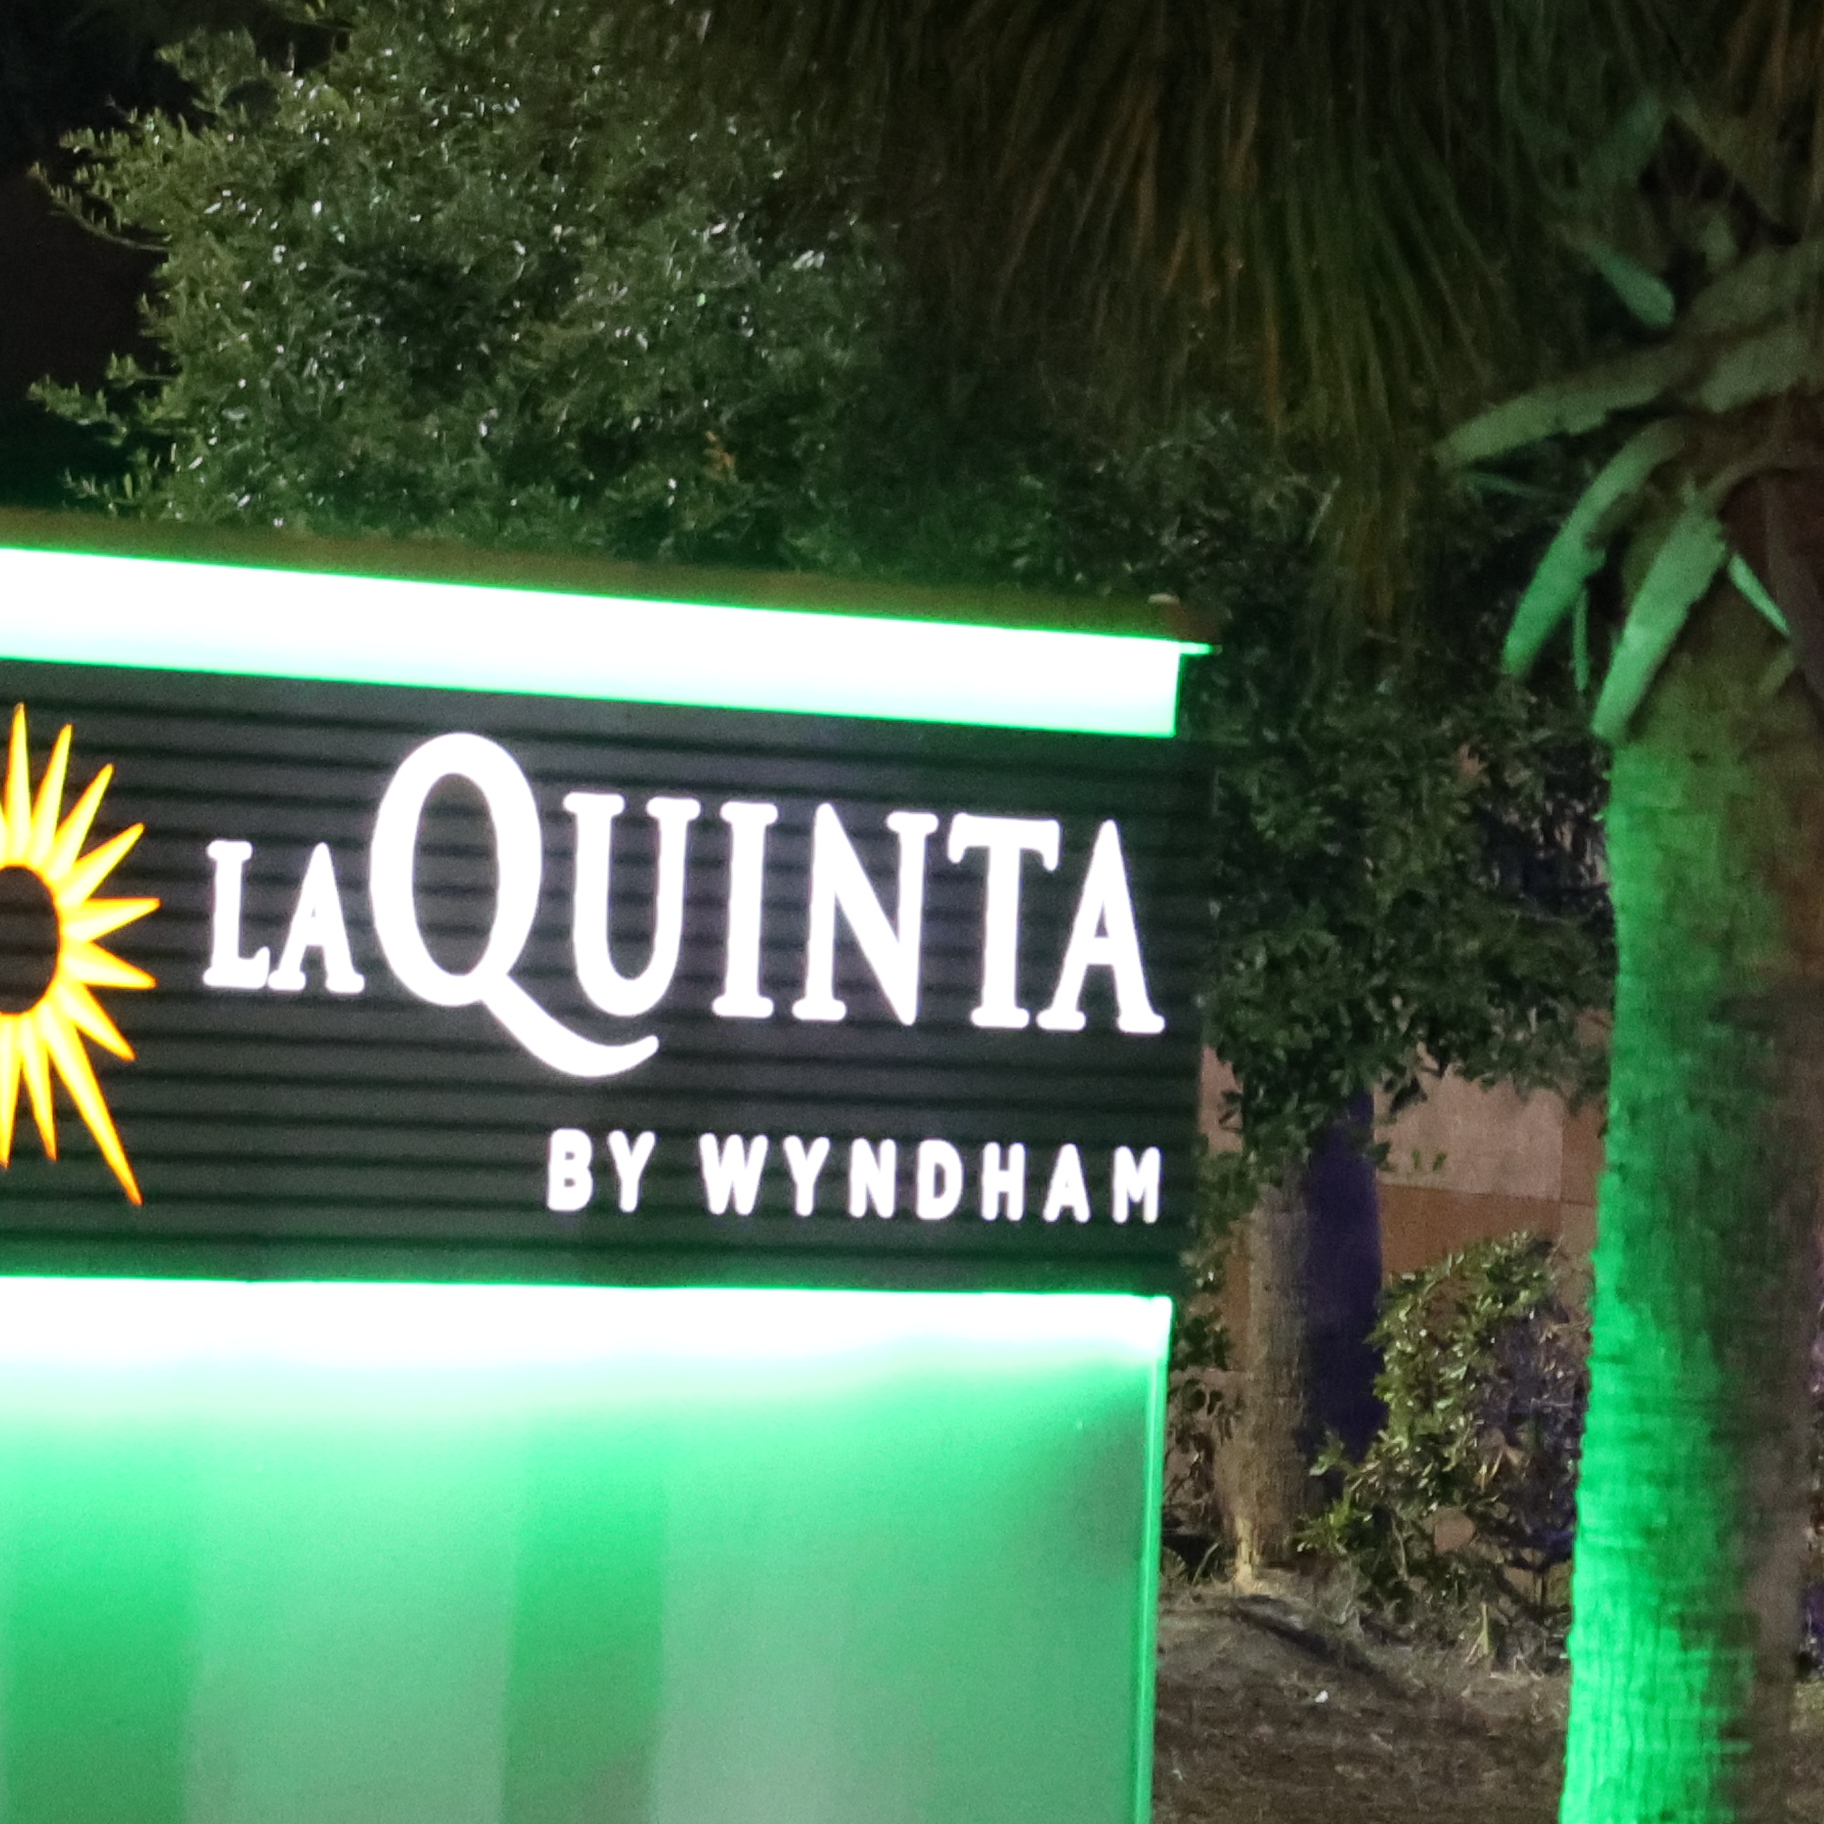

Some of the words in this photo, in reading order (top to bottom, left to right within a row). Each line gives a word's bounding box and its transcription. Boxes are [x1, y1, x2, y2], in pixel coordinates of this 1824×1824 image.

[202, 839, 366, 996] LA
[365, 731, 1165, 1080] QUINTA
[546, 1128, 656, 1213] BY
[698, 1132, 1161, 1223] WYNDHAM
